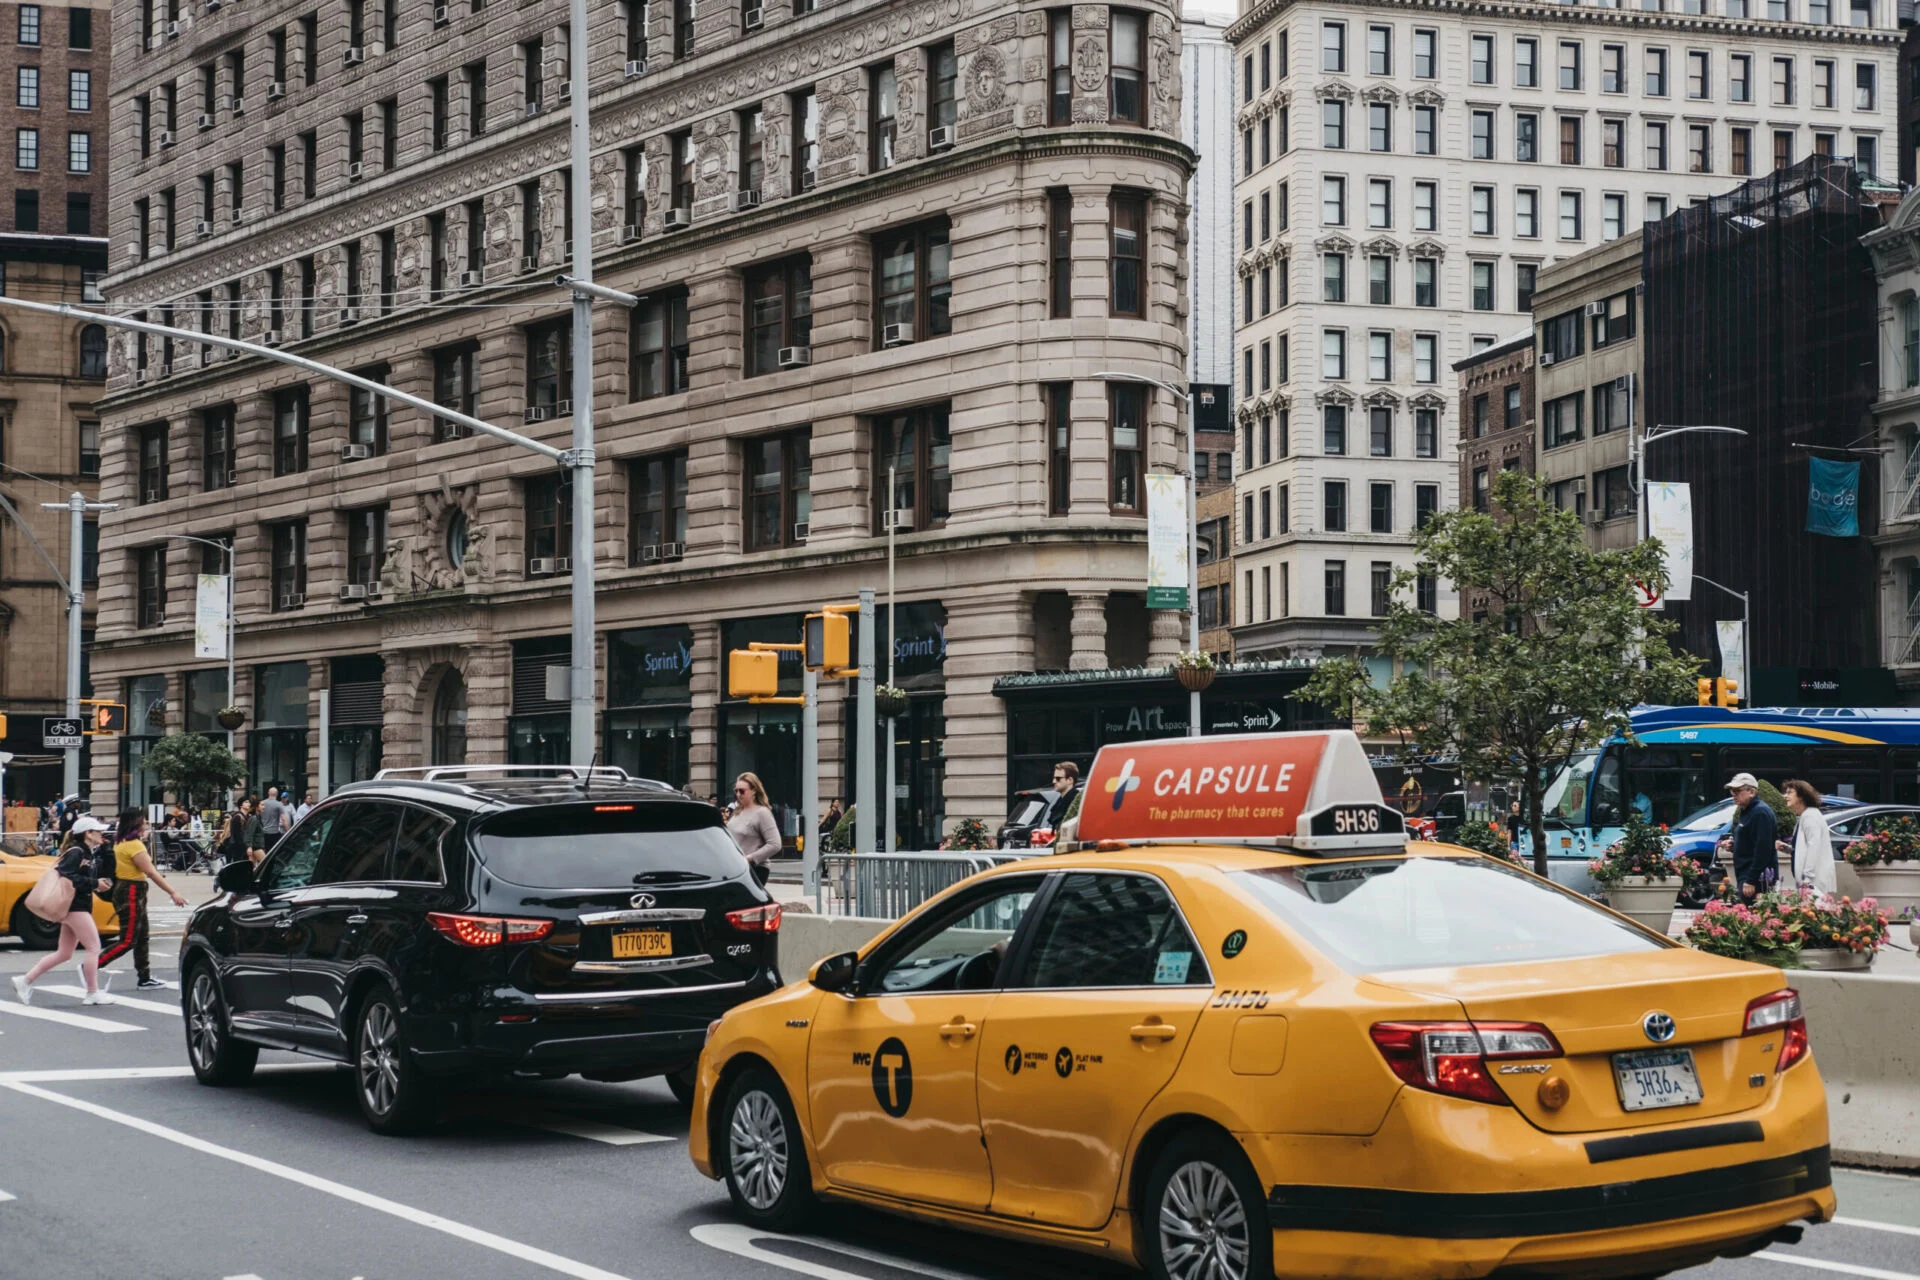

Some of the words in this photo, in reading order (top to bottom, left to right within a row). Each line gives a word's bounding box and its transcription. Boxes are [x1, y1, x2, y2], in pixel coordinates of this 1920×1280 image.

[894, 635, 935, 663] Sprint
[644, 651, 679, 677] Sprint
[1106, 723, 1124, 733] Prow
[1126, 705, 1164, 732] Art
[1243, 715, 1269, 730] Sprint
[46, 737, 62, 745] BIKE
[64, 736, 81, 745] LANE
[1153, 763, 1296, 796] CAPSULE
[1149, 806, 1168, 820] The
[1170, 804, 1223, 821] pharmacy
[1227, 804, 1249, 818] that
[1253, 806, 1285, 818] cares
[1335, 808, 1379, 833] 5H36
[617, 933, 666, 952] T770739C
[1212, 990, 1270, 1009] 5H36
[853, 1052, 871, 1066] NYC
